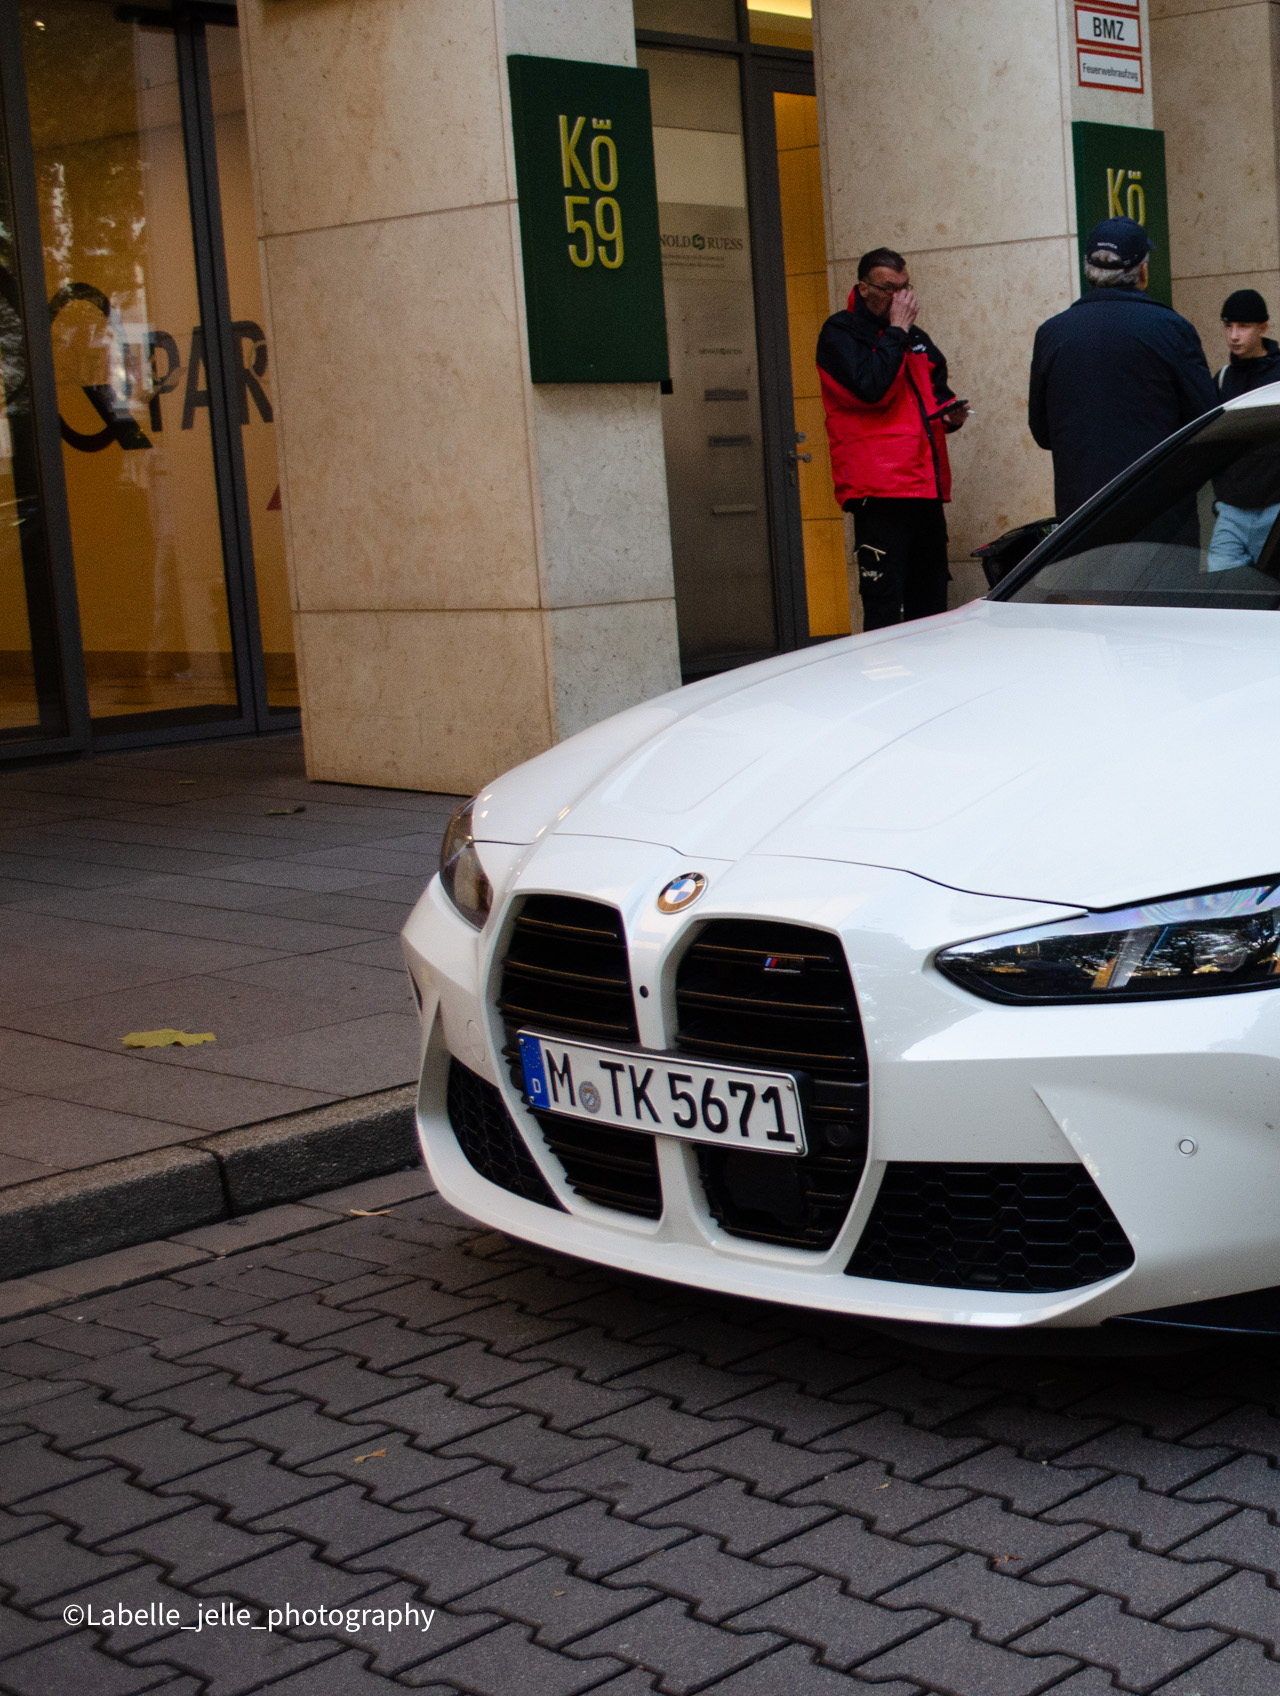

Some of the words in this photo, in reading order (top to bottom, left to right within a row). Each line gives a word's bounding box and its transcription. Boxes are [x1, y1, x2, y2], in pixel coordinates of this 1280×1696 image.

[1093, 16, 1125, 41] BMZ
[564, 195, 625, 269] 59
[707, 236, 744, 250] RUESS
[531, 1077, 542, 1094] D
[545, 1048, 577, 1107] M
[599, 1059, 662, 1124] TK
[667, 1071, 796, 1143] 5671
